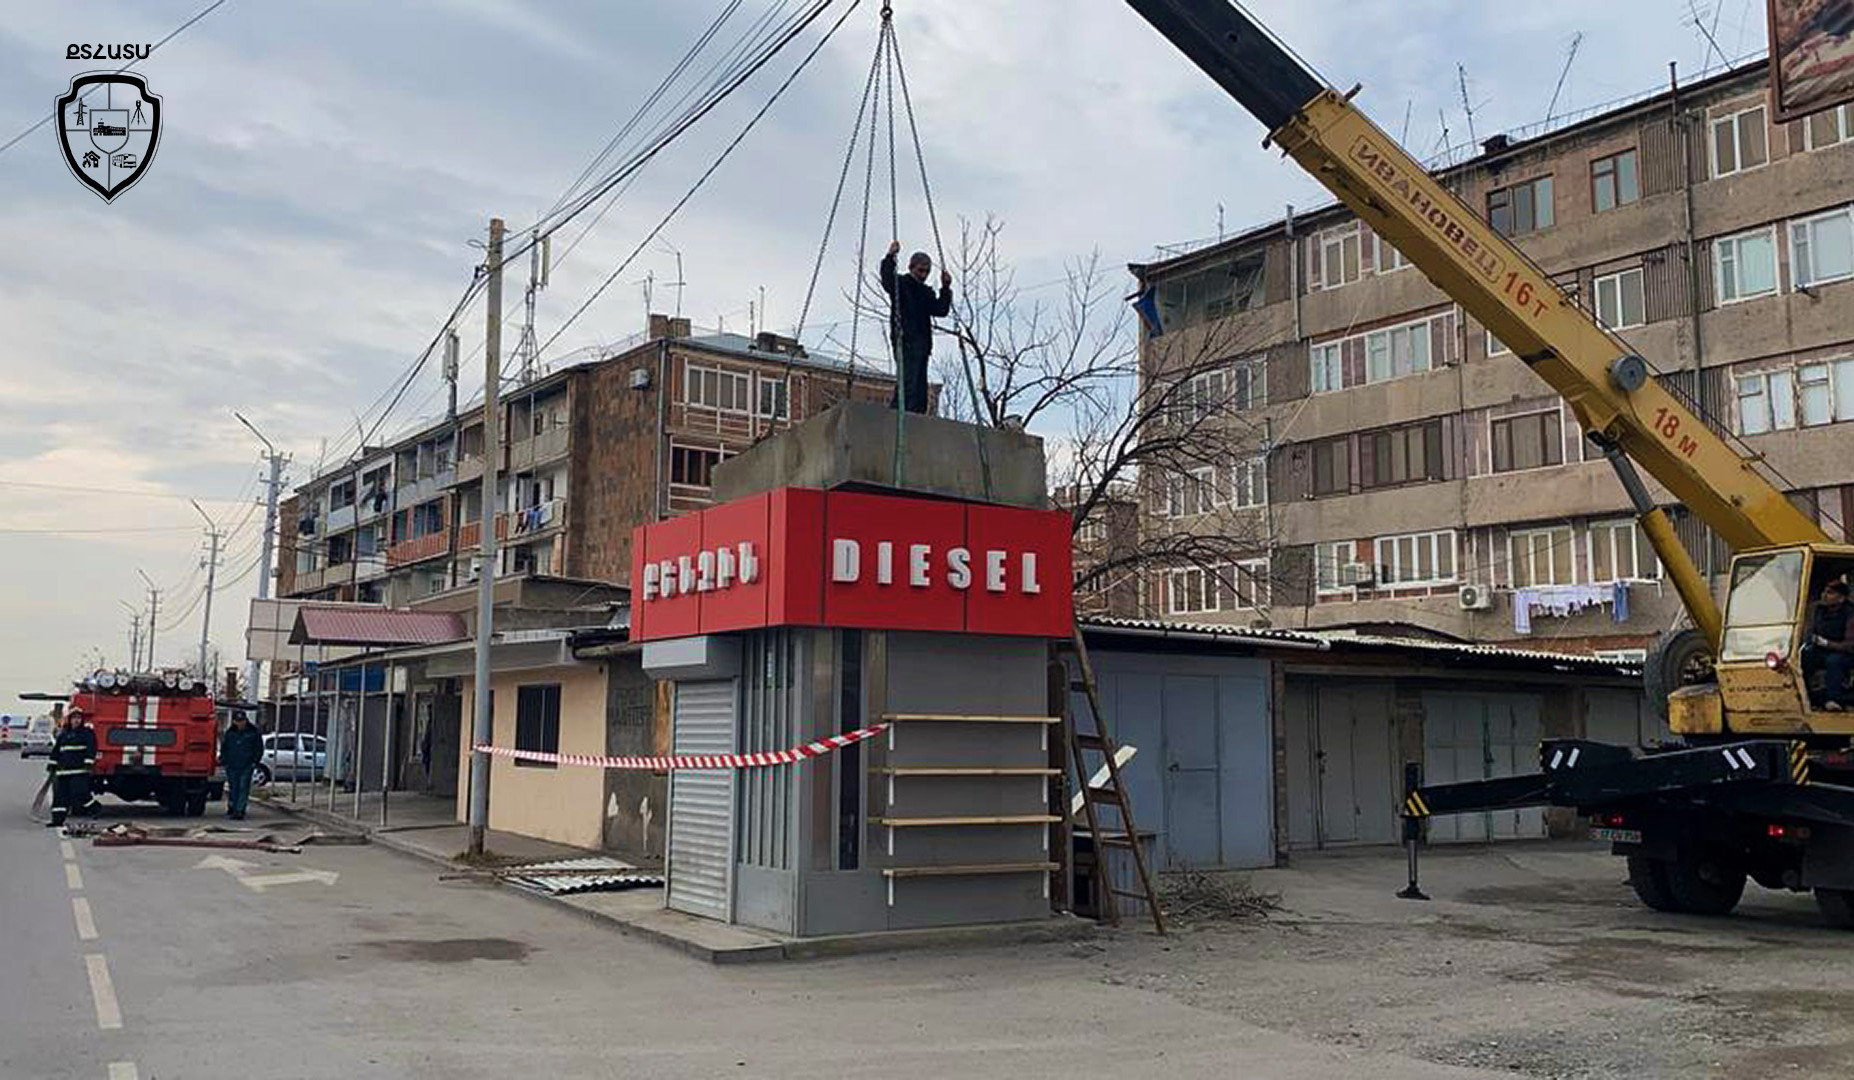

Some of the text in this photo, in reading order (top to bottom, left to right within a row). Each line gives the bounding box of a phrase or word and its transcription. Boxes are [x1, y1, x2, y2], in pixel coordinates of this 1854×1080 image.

[1357, 144, 1498, 276] ИВАНОВЕЦ
[643, 541, 758, 601] ԲԵՆԶԻՆ
[832, 539, 1040, 593] DIESEL
